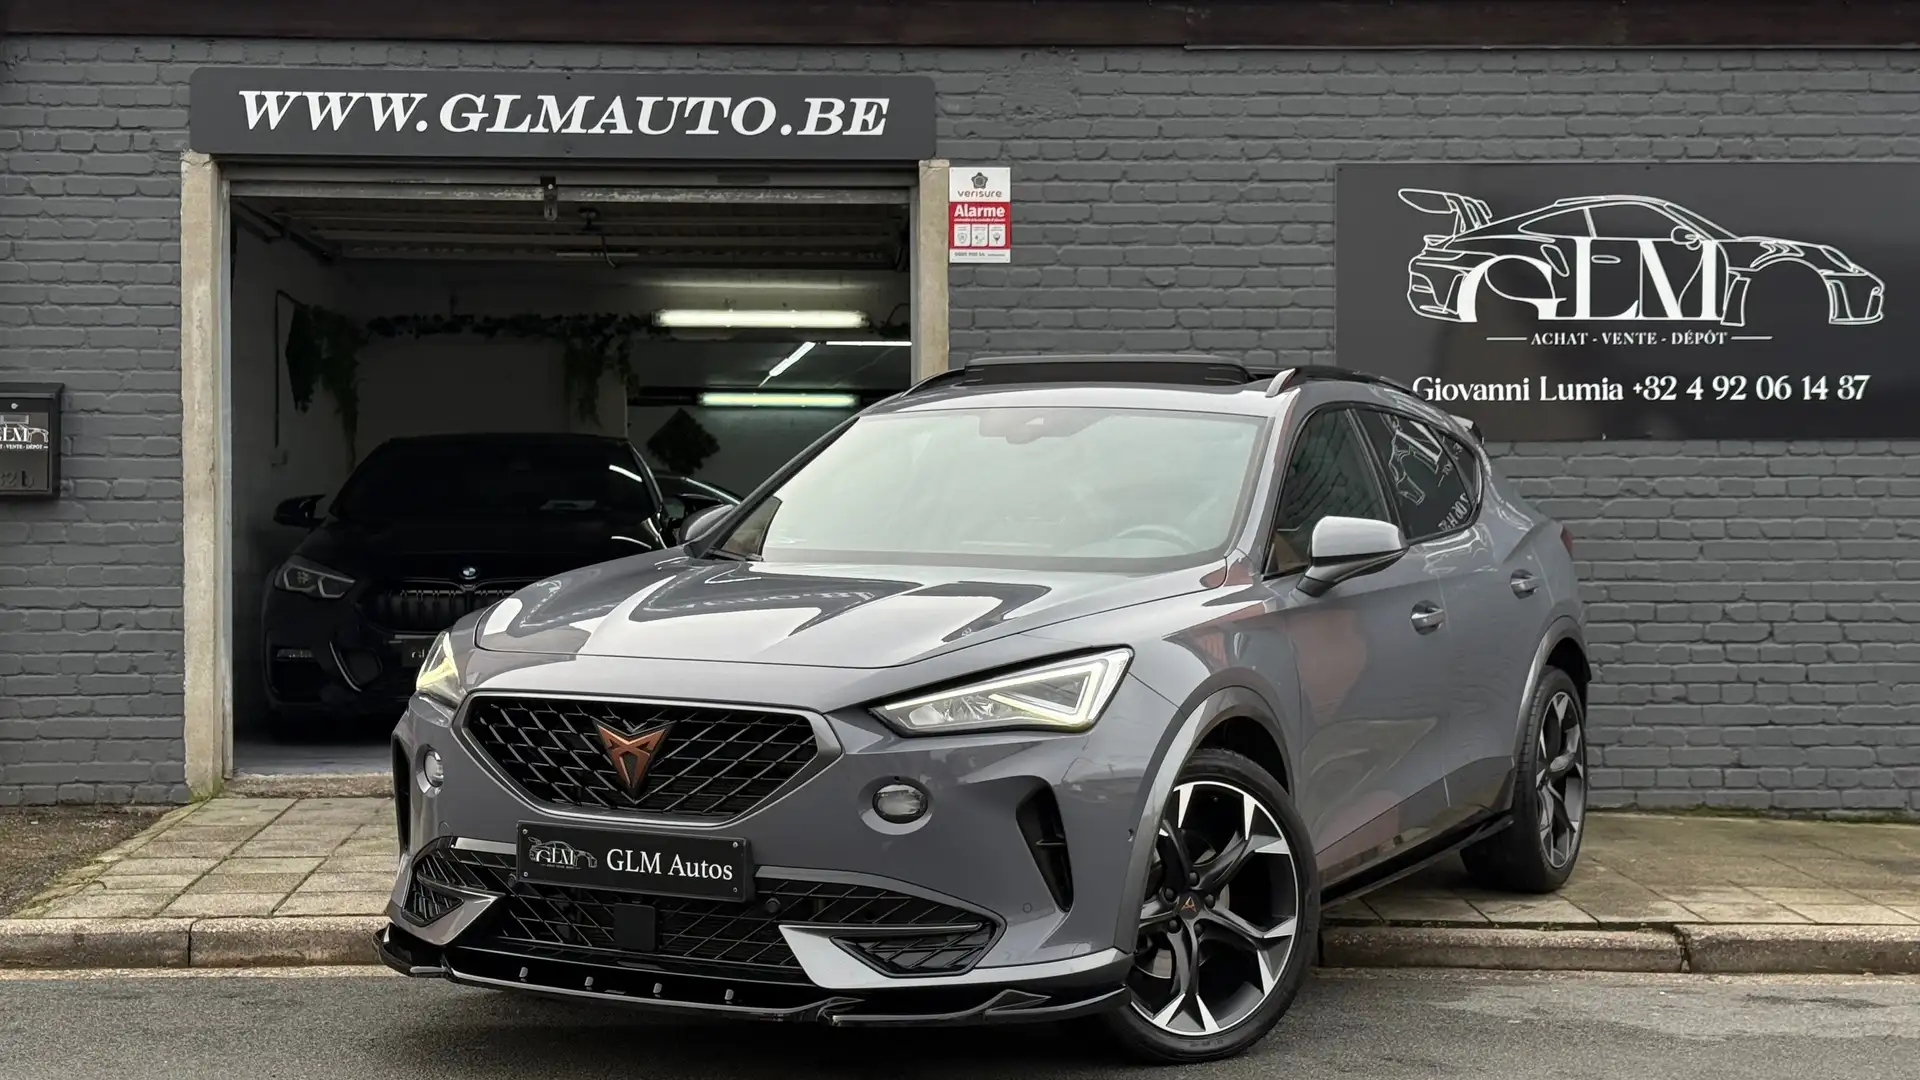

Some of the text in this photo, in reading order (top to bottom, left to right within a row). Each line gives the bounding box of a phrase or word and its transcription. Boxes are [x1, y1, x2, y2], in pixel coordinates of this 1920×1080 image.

[238, 90, 890, 137] WWW.GLMAUTO.BE
[957, 190, 1002, 198] verisure
[954, 203, 1005, 217] Alarme
[1456, 237, 1724, 323] GLM
[1530, 332, 1589, 346] ACHAT
[1601, 331, 1658, 345] VENTE
[1671, 330, 1729, 345] DÉPÔT
[1412, 374, 1871, 402] Giovanni Lumia +32 4 92 06 14 37
[0, 427, 28, 442] LM
[606, 848, 733, 881] GLM Autos
